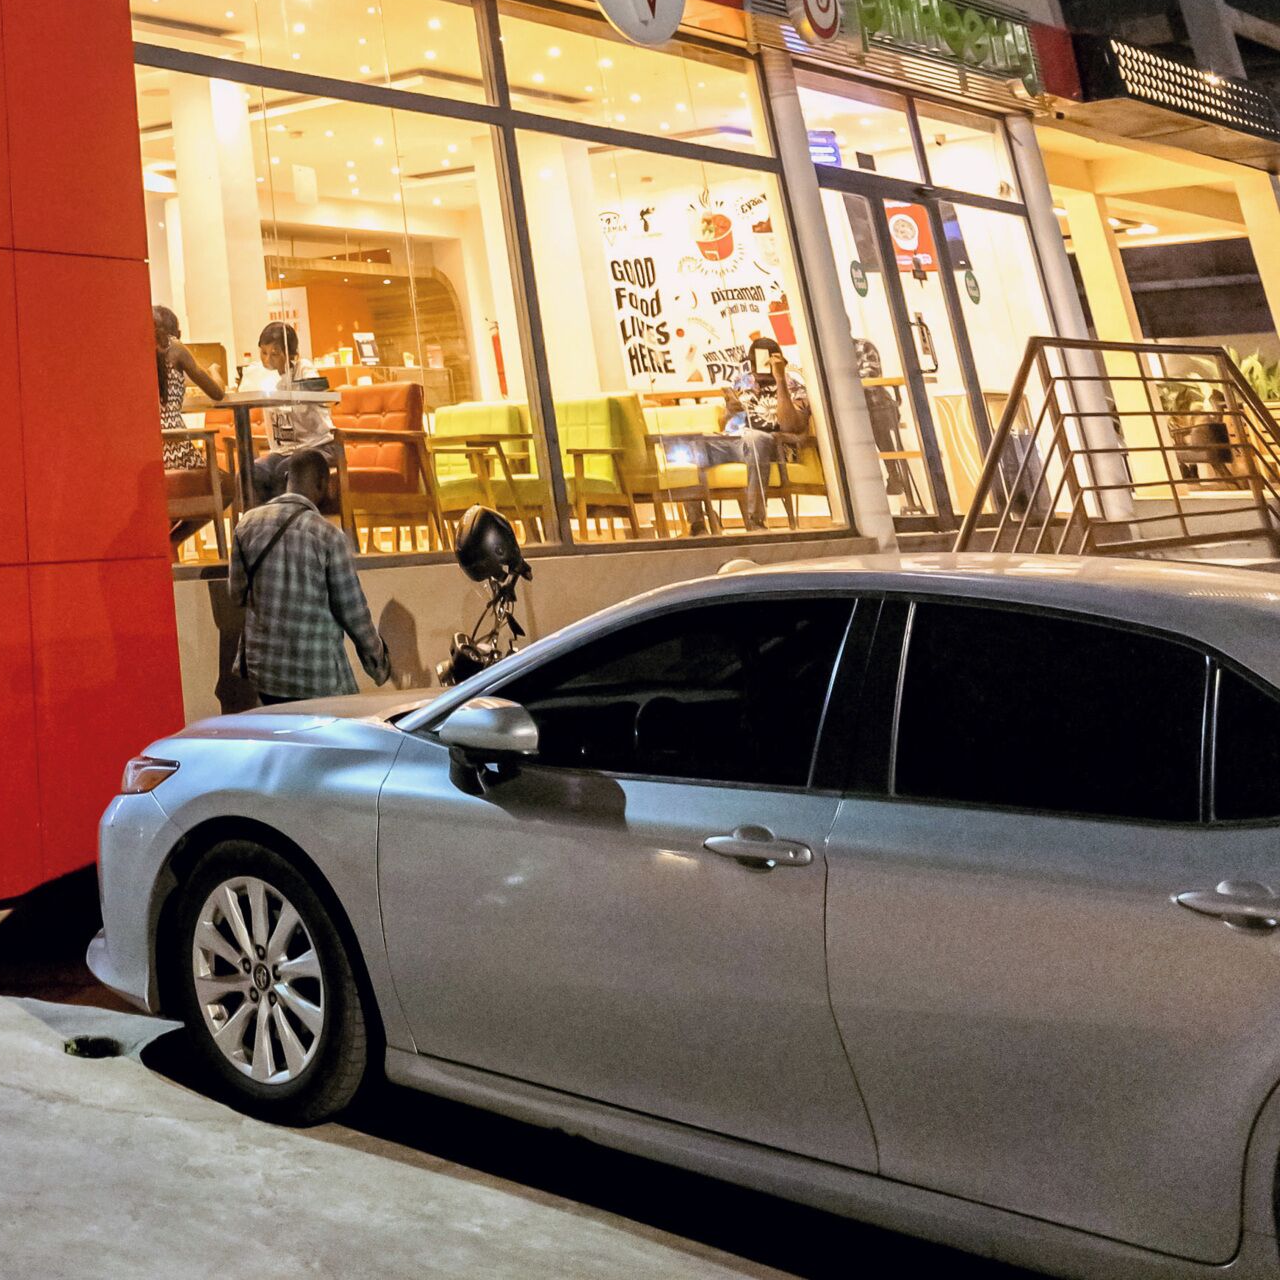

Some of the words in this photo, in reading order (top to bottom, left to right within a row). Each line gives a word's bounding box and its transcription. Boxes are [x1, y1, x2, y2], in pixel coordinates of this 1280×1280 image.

[610, 256, 656, 288] GOOD
[711, 285, 766, 304] pizzaman
[620, 316, 670, 345] LIVES
[628, 343, 676, 376] HERE
